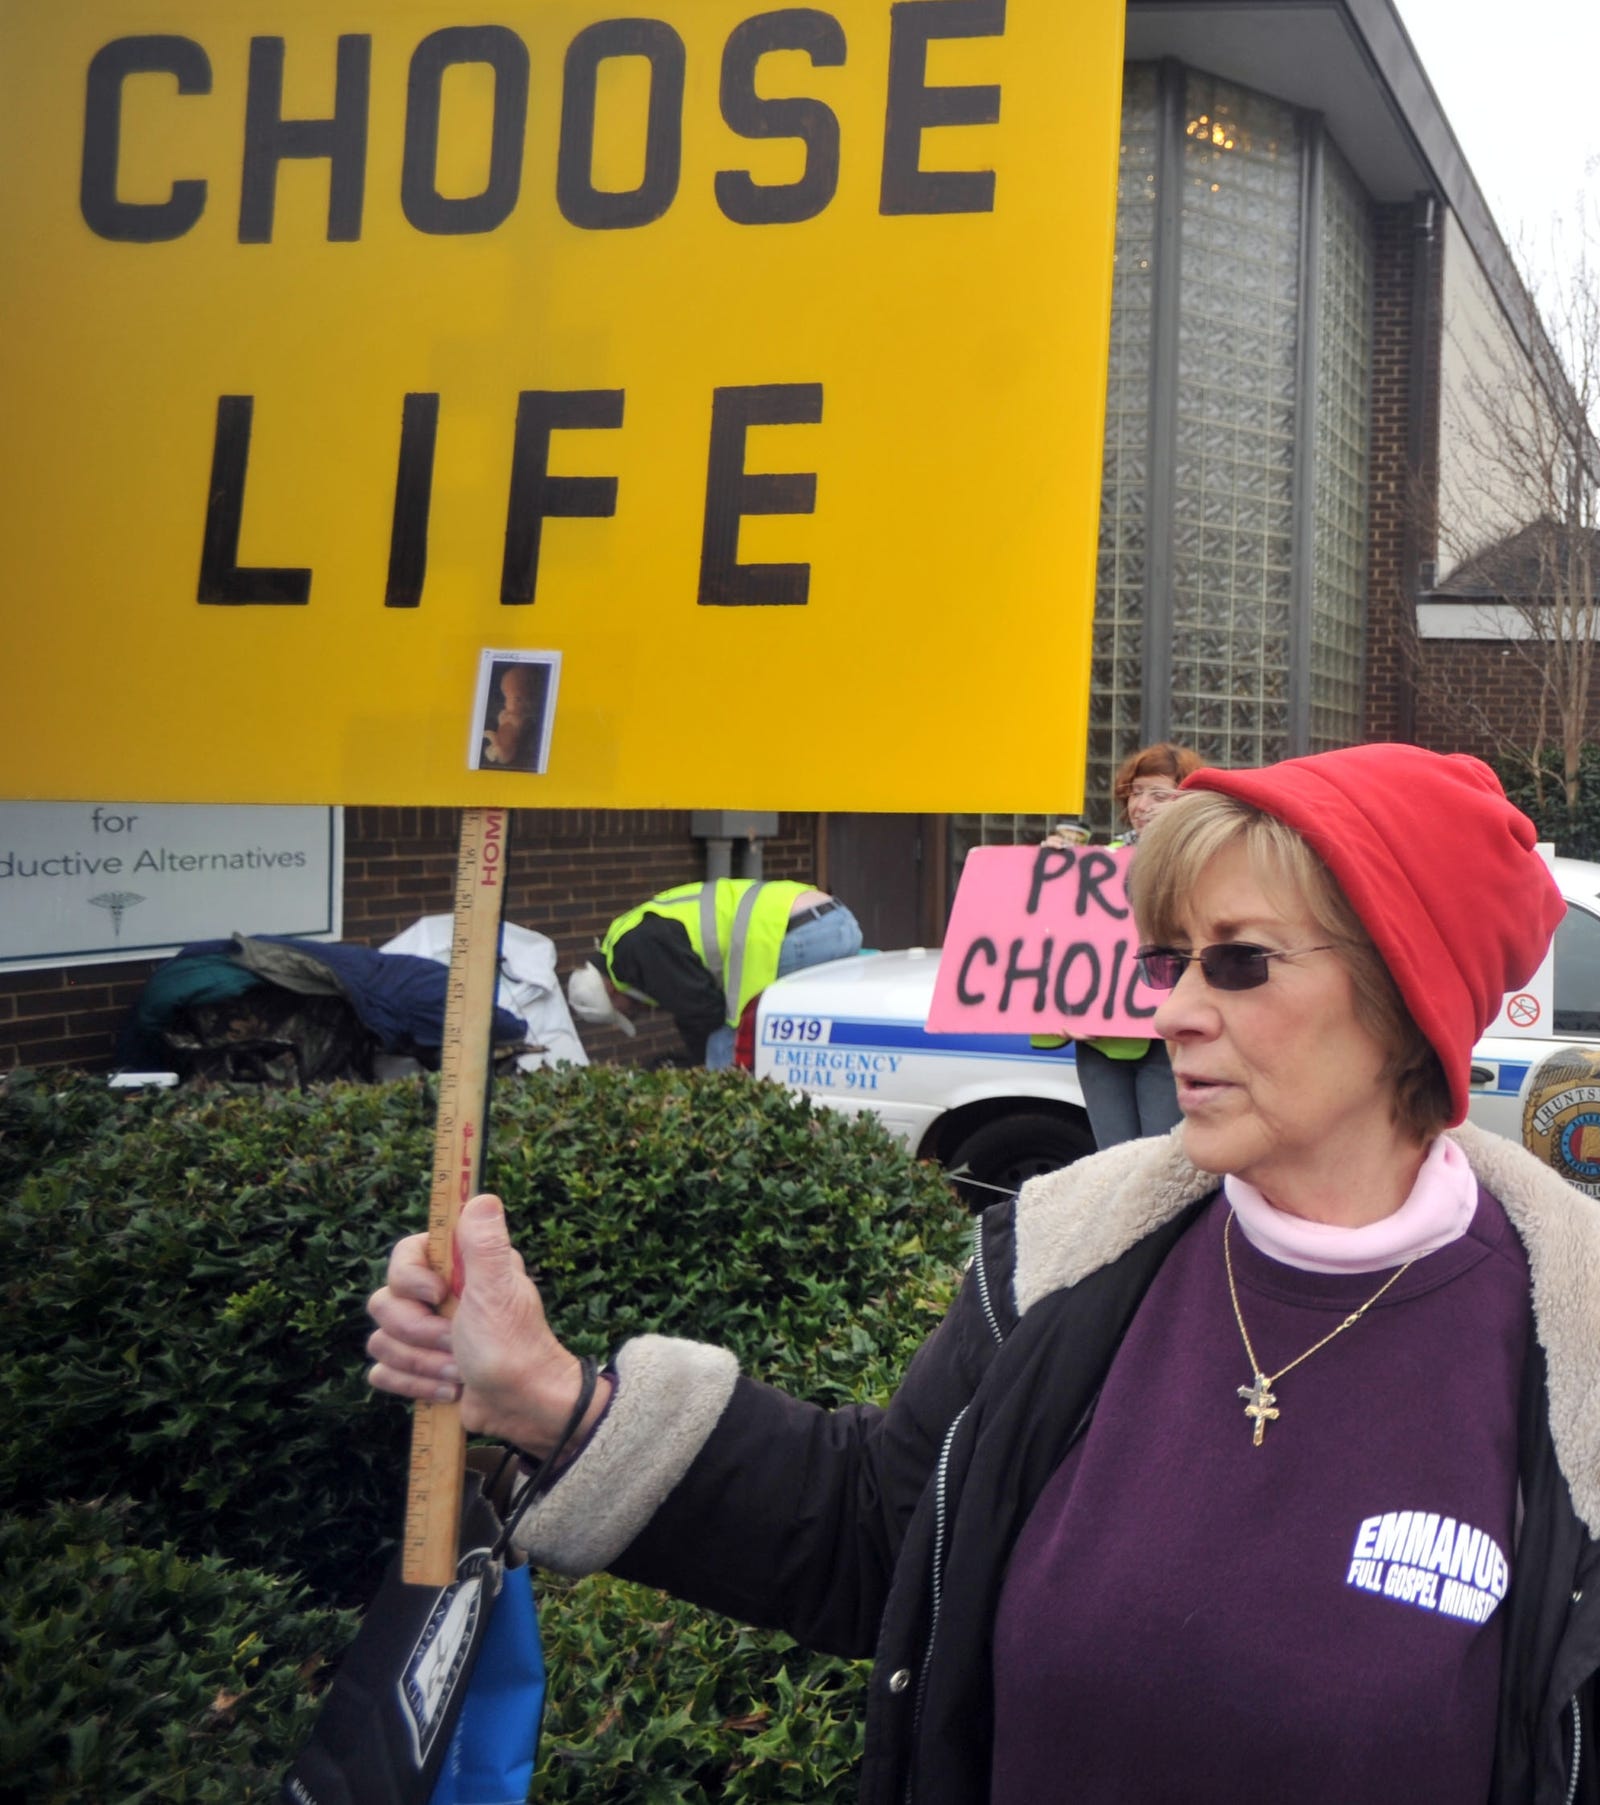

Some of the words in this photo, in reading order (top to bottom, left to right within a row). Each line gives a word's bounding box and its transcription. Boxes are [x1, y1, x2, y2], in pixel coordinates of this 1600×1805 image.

[79, 0, 1006, 245] CHOOSE
[196, 382, 824, 608] LIFE
[92, 807, 138, 833] for
[133, 845, 306, 873] Alternatives
[481, 806, 503, 886] HOM
[1026, 847, 1135, 920] PR
[956, 936, 1158, 1020] CHOIC
[769, 1018, 822, 1041] 1919
[774, 1049, 901, 1073] EMERGENCY
[788, 1068, 835, 1087] DIAL
[846, 1072, 879, 1089] 911
[1346, 1559, 1385, 1593] FULL
[1384, 1563, 1440, 1609] GOSPEL
